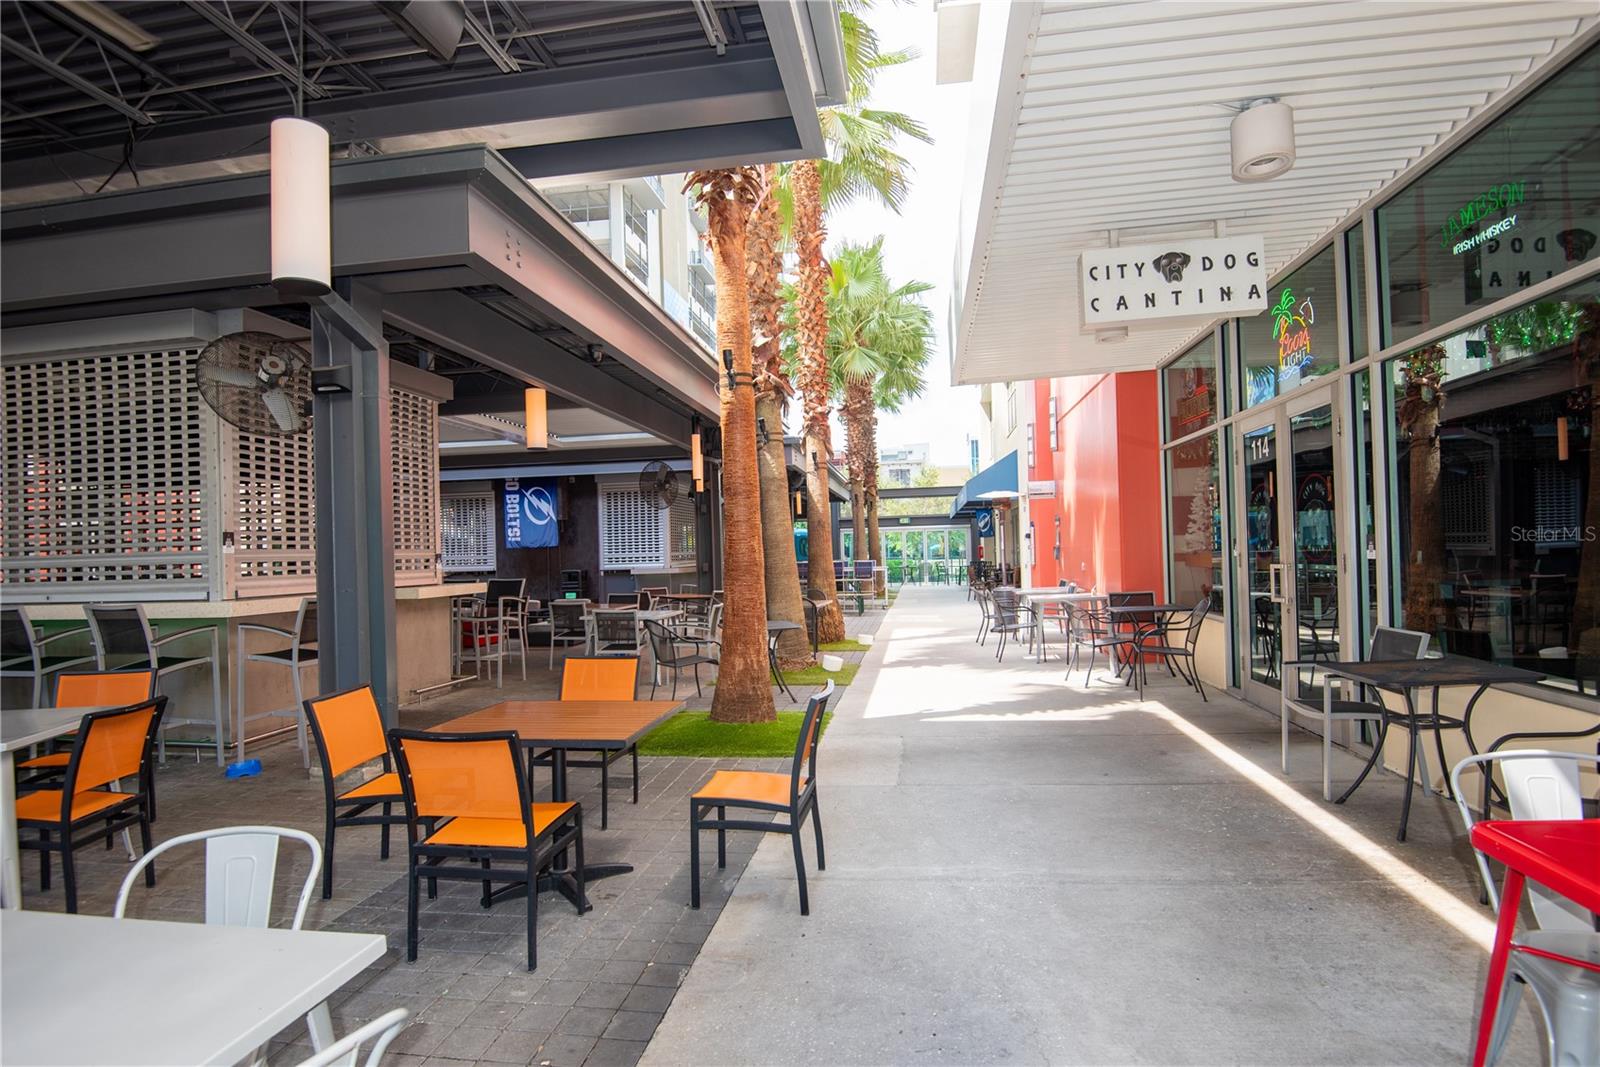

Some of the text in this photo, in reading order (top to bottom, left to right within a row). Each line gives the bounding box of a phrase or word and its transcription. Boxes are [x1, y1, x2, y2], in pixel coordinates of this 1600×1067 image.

[1439, 180, 1526, 248] JAMESON
[1452, 214, 1518, 256] IRISH WHISKEY
[1089, 251, 1259, 282] CITY DOG
[1090, 284, 1261, 313] CANTINA
[1280, 329, 1310, 357] Coors
[1282, 346, 1308, 369] LIGHT
[1251, 436, 1270, 461] 114
[505, 494, 521, 542] BOLTS!
